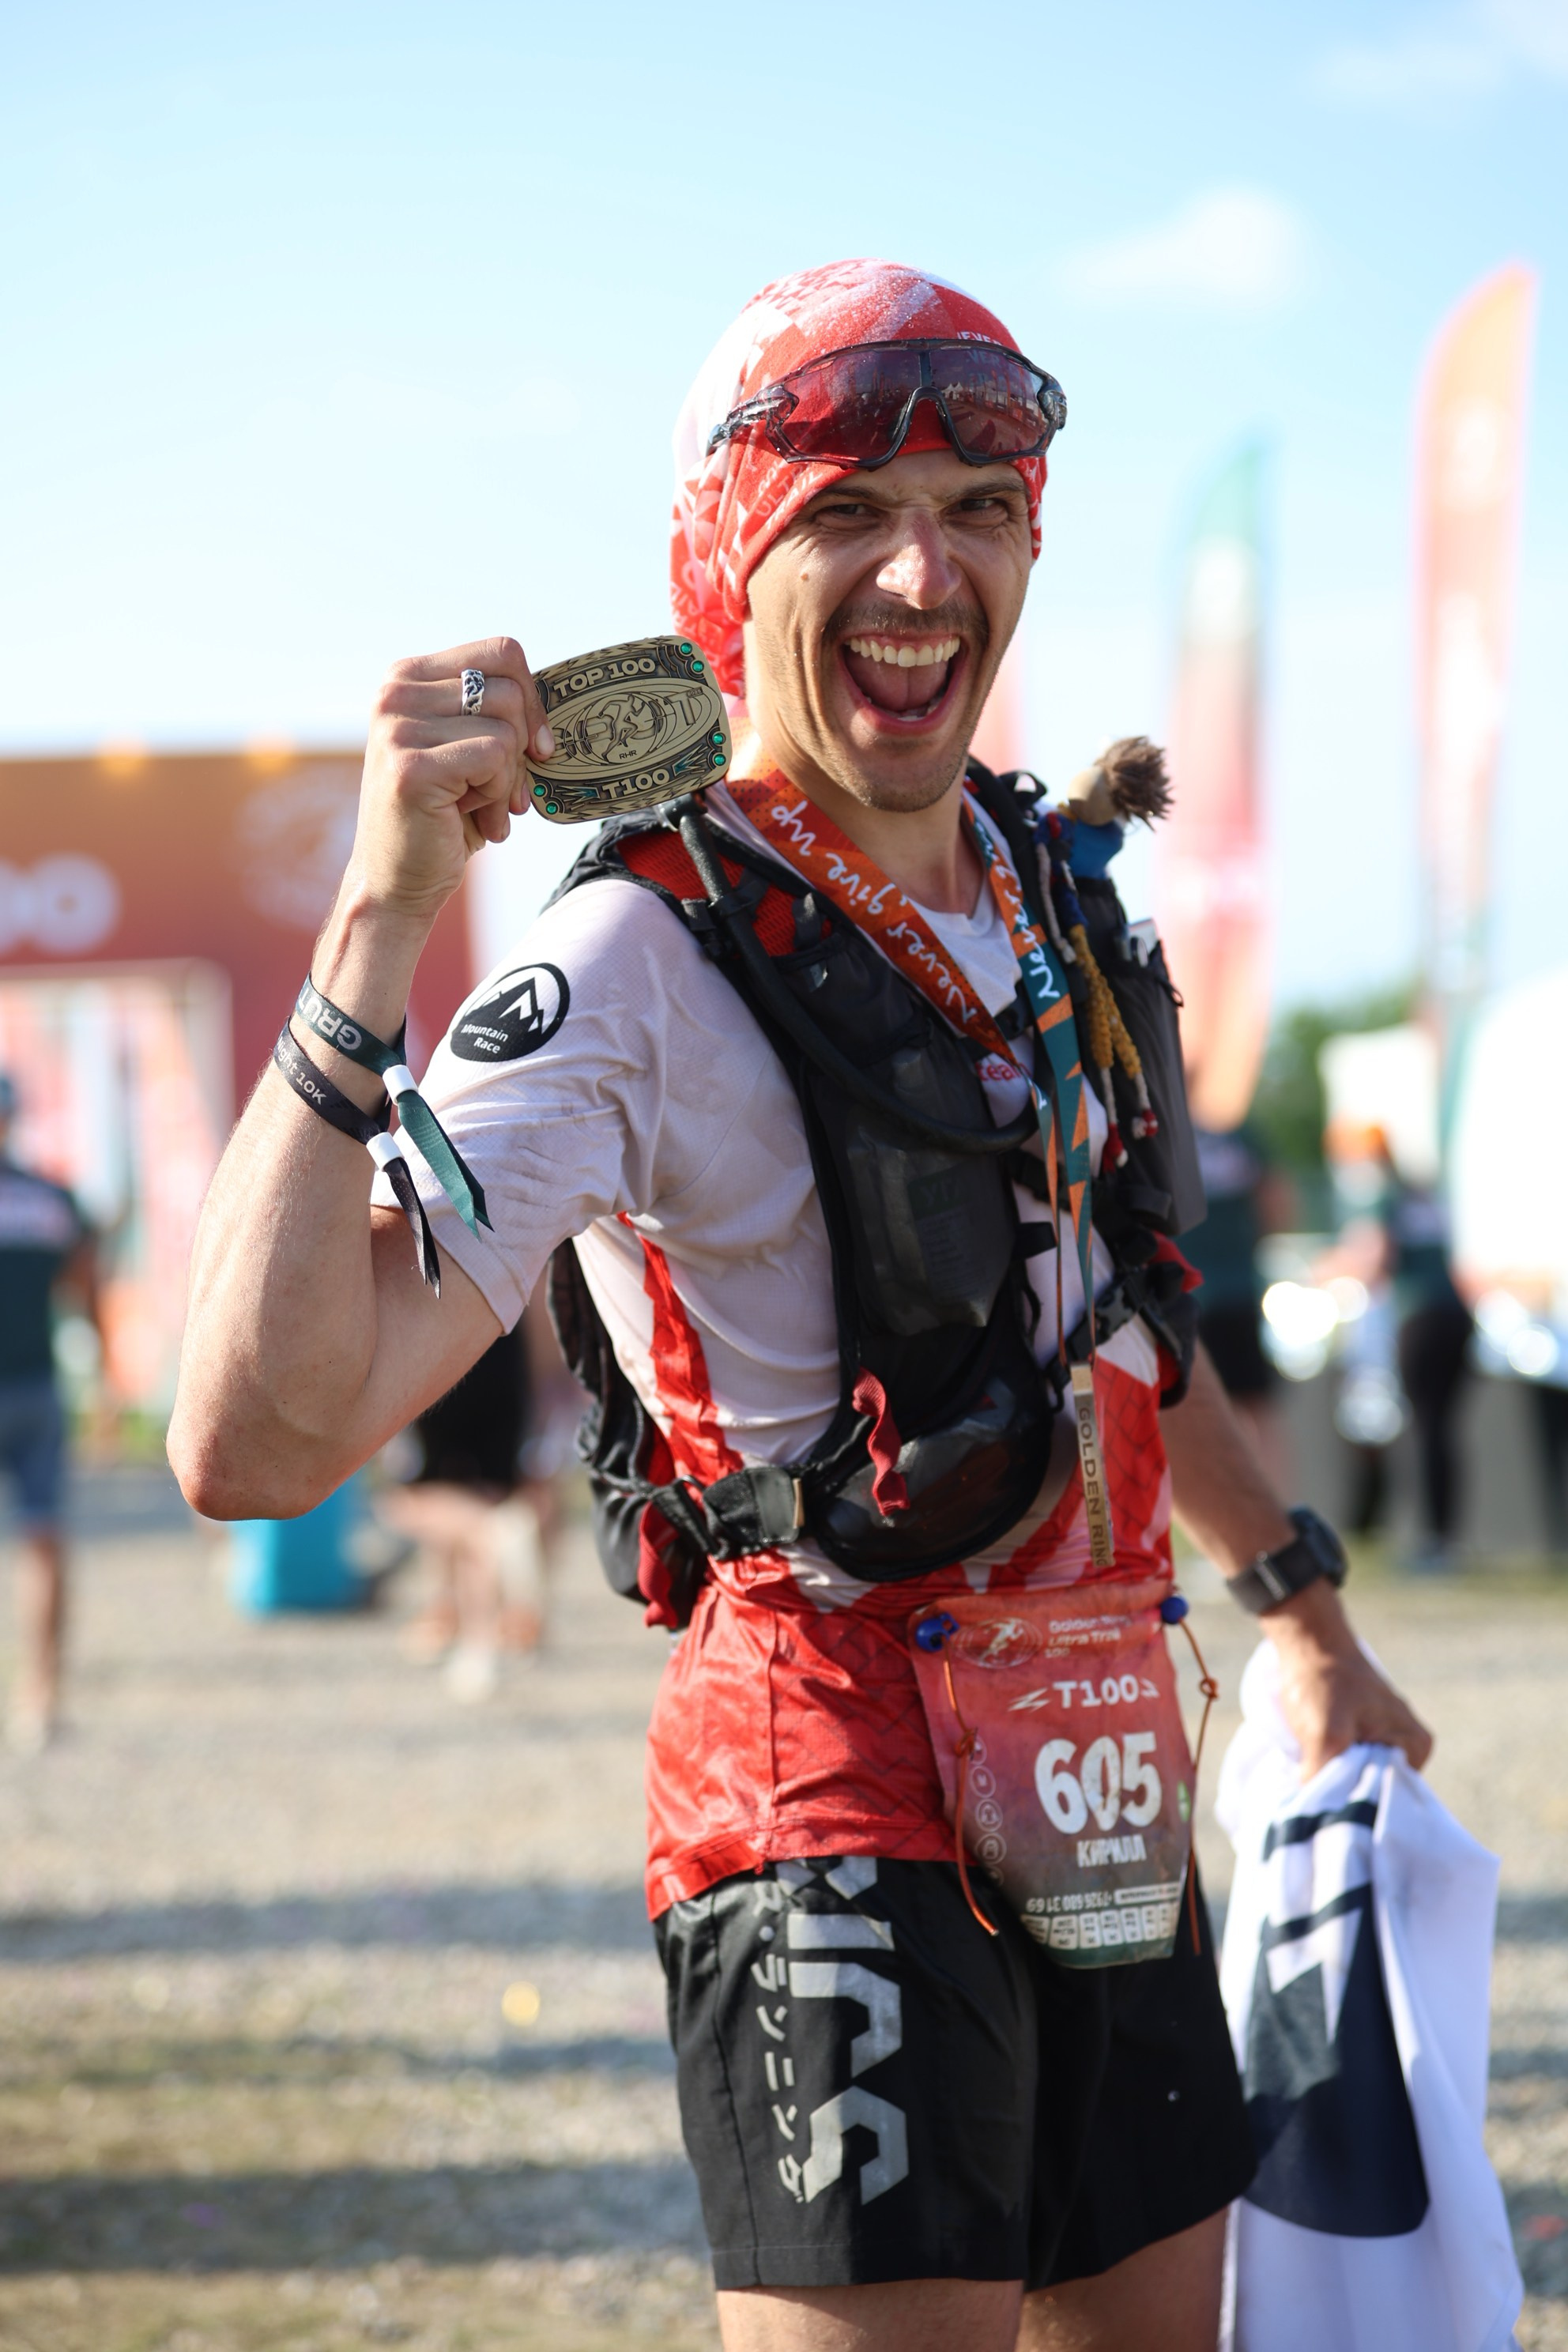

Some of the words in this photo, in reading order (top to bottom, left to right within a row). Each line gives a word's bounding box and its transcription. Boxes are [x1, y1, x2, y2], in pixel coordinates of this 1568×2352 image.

[553, 668, 604, 698] TOP
[608, 658, 656, 679] 100
[618, 749, 638, 760] RHR
[602, 768, 670, 799] T100
[771, 800, 816, 856] up
[461, 1023, 508, 1042] Mountain
[473, 1037, 500, 1054] Race
[296, 1072, 326, 1105] 10K
[1079, 1407, 1102, 1515] GOLDEN
[1091, 1524, 1106, 1566] RING
[1053, 1674, 1140, 1709] T100
[1034, 1731, 1163, 1834] 605
[1026, 1898, 1045, 1913] 69
